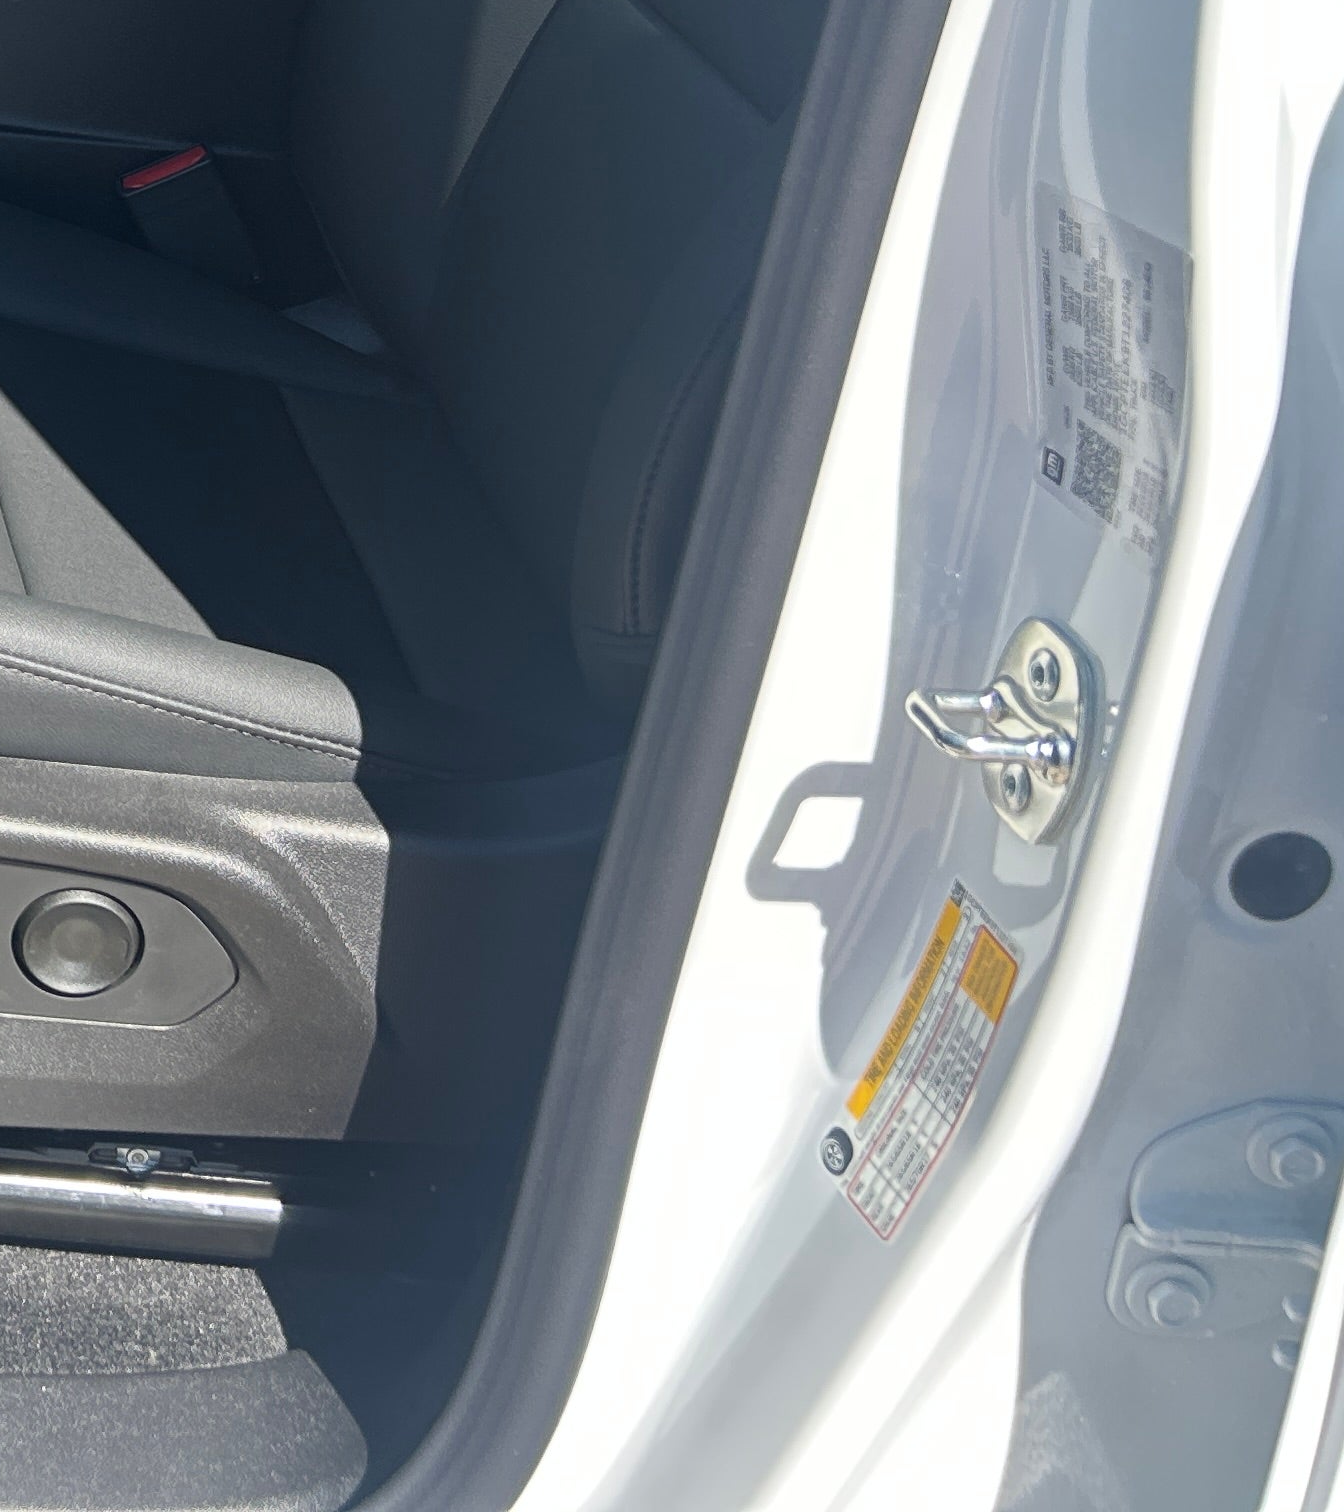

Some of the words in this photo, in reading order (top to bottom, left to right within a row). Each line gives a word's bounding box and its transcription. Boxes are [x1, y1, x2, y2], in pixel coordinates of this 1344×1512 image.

[1041, 247, 1051, 266] LLC
[1042, 267, 1051, 306] MOTORS
[1044, 310, 1055, 351] GENERAL
[864, 1063, 882, 1085] TIRE
[876, 1041, 893, 1066] AND
[888, 999, 916, 1045] LOADING
[909, 936, 945, 1003] INFORMATION
